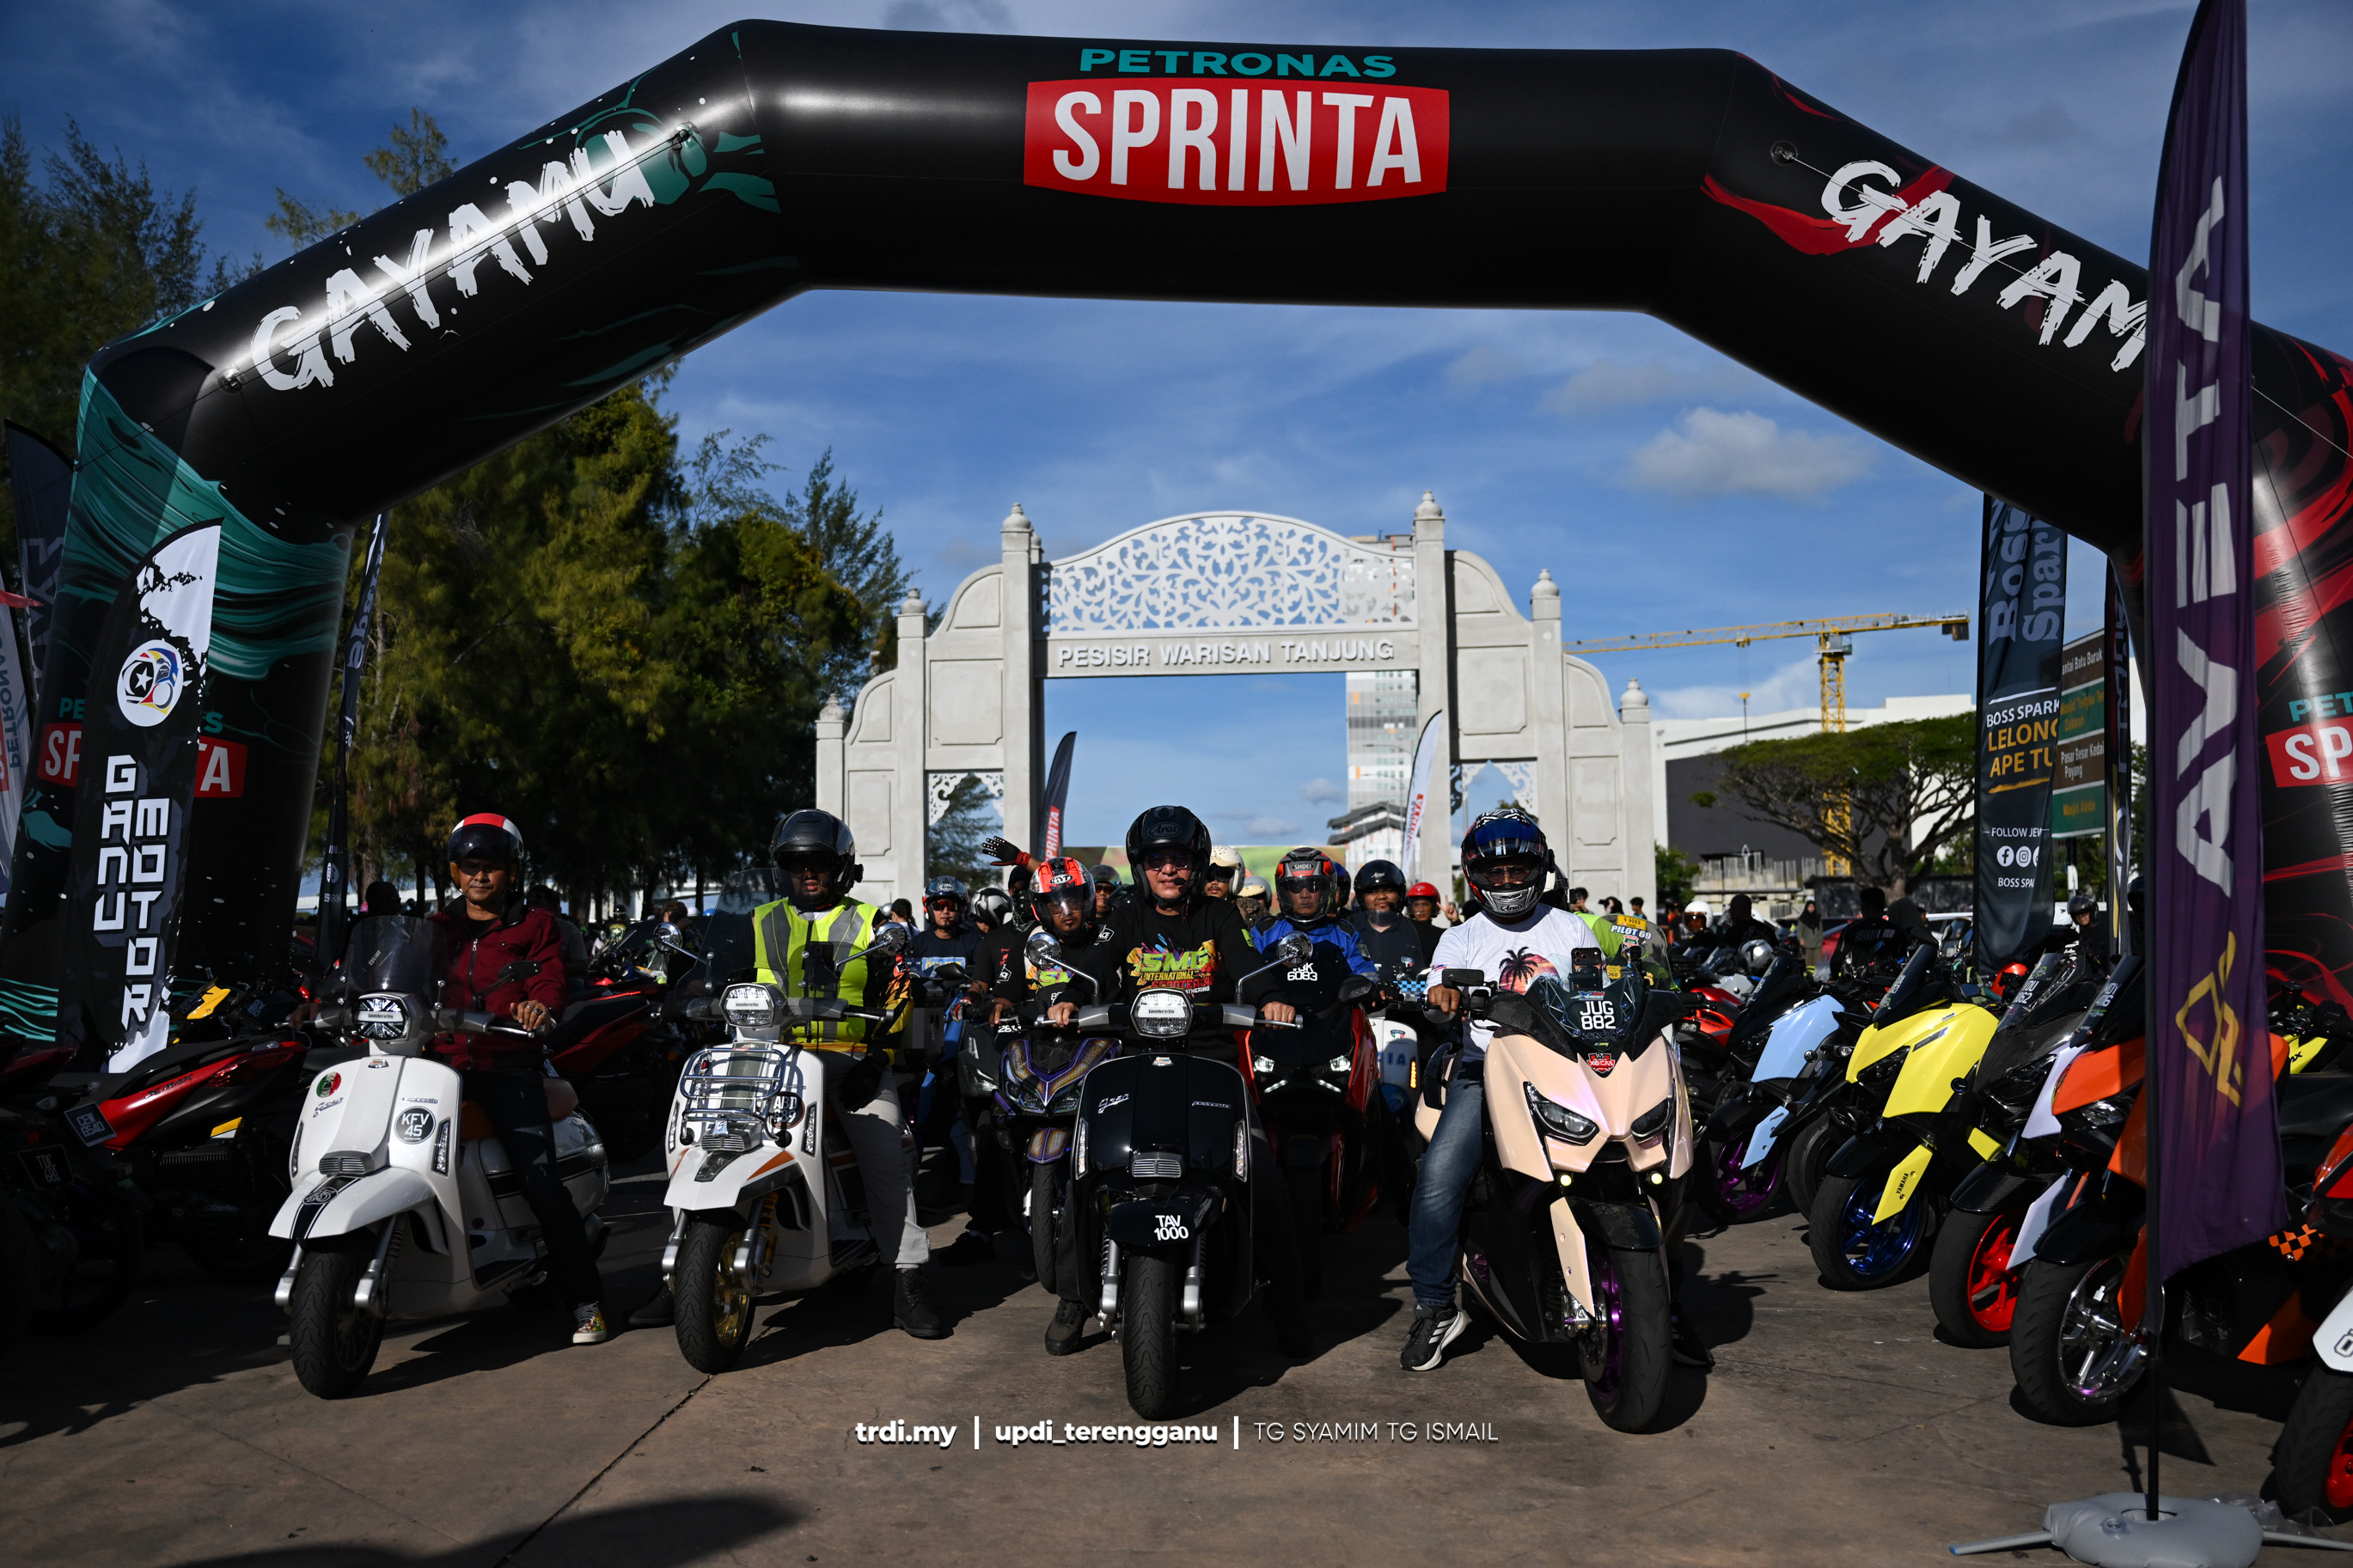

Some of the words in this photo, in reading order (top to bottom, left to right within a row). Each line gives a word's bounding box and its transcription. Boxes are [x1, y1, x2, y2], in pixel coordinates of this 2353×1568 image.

[1079, 48, 1397, 78] PETRONAS
[1053, 88, 1422, 192] SPRINTA
[251, 130, 656, 391] GAYAMU
[1821, 160, 2147, 373] GAYAM
[2175, 175, 2238, 899] AVETA
[2022, 520, 2064, 642] Spar
[1058, 644, 1151, 668] PESISIR
[1159, 642, 1272, 665] WARISAN
[1280, 638, 1395, 662] TANJUNG
[2062, 661, 2075, 675] antai
[2075, 656, 2087, 670] Batu
[2087, 648, 2103, 667] Buruk
[1986, 709, 2015, 728] BOSS
[2061, 748, 2075, 765] Pasar
[2089, 741, 2105, 758] Kedai
[1989, 751, 2025, 778] APE
[2064, 765, 2083, 781] Payang
[1045, 811, 1060, 862] PRINTA
[1153, 824, 1178, 834] Arai
[1991, 827, 2028, 838] FOLLOW
[94, 754, 138, 931] GANU
[1997, 877, 2020, 888] BOSS
[120, 798, 170, 1030] MOTOR
[1500, 903, 1523, 912] Arai
[1610, 924, 1639, 936] PILOT
[1638, 930, 1653, 940] 69
[1287, 971, 1318, 982] 6083
[1579, 1000, 1614, 1016] JUG
[1580, 1015, 1617, 1030] 882
[401, 1113, 431, 1126] KFV
[404, 1125, 424, 1138] 45
[1896, 1173, 1910, 1194] YAMAHA
[1154, 1214, 1182, 1227] TAV
[1153, 1226, 1189, 1242] 1000
